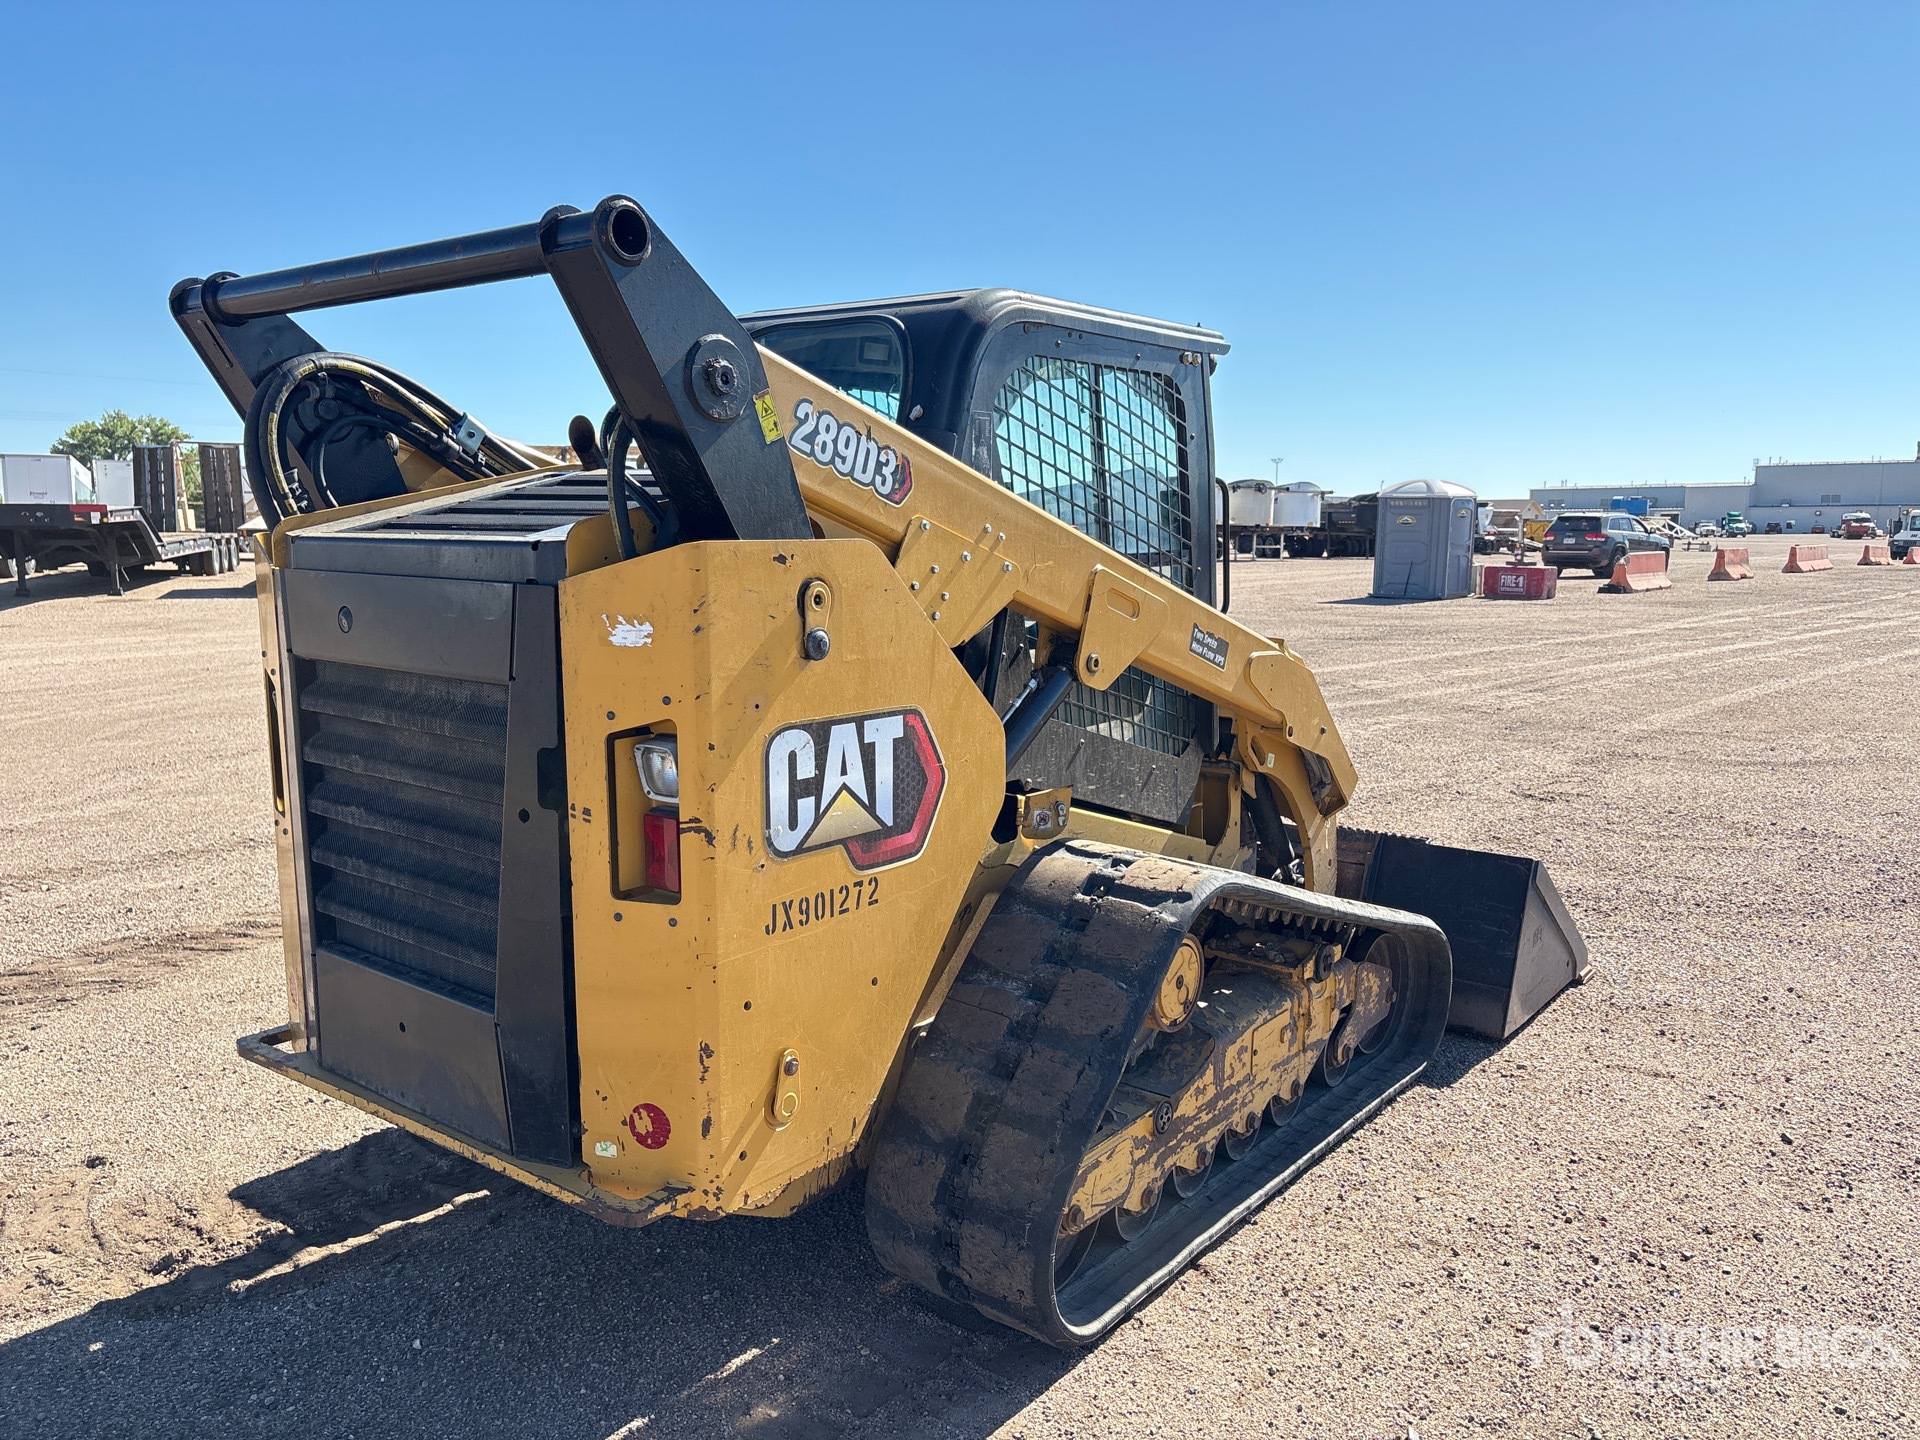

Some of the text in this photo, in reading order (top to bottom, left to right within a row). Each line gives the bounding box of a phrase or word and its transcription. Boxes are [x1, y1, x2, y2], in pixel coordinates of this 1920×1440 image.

[791, 402, 897, 495] 289D3
[768, 715, 904, 852] CAT
[764, 876, 879, 936] JX901272
